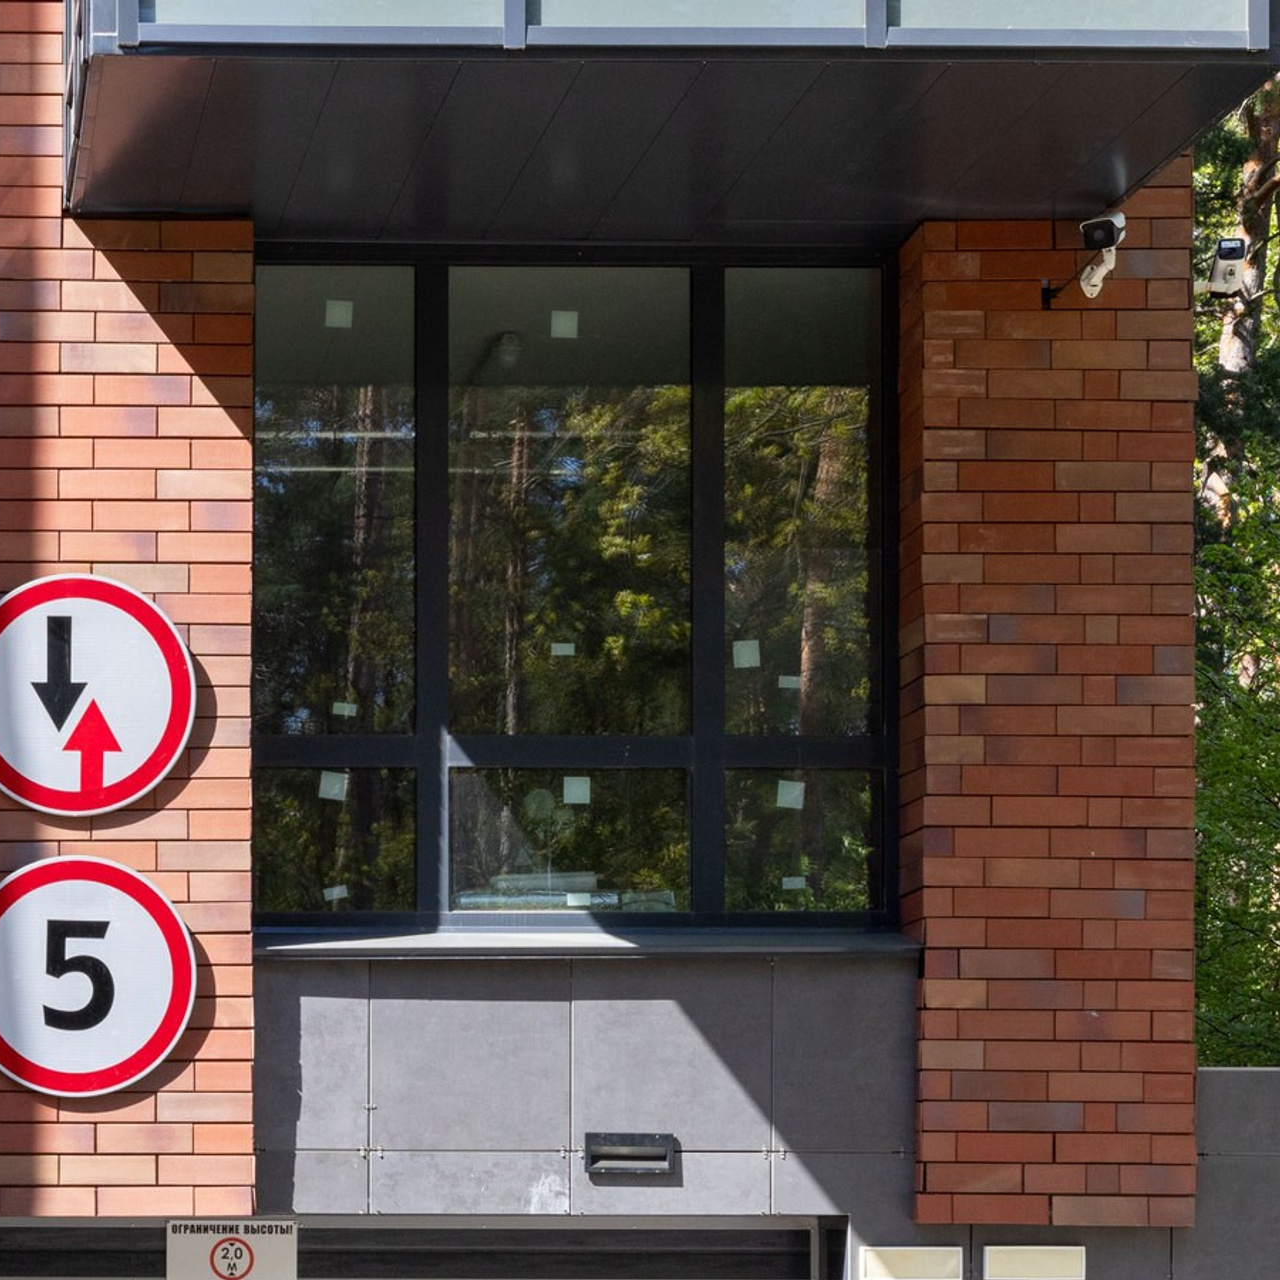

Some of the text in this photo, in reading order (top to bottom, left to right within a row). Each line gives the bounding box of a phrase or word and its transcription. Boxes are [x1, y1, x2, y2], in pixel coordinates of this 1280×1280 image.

[42, 919, 115, 1031] 5
[171, 1224, 293, 1235] ОГРАНИЧЕНИЕ ВЫСОТЫ!
[221, 1247, 243, 1261] 2,0
